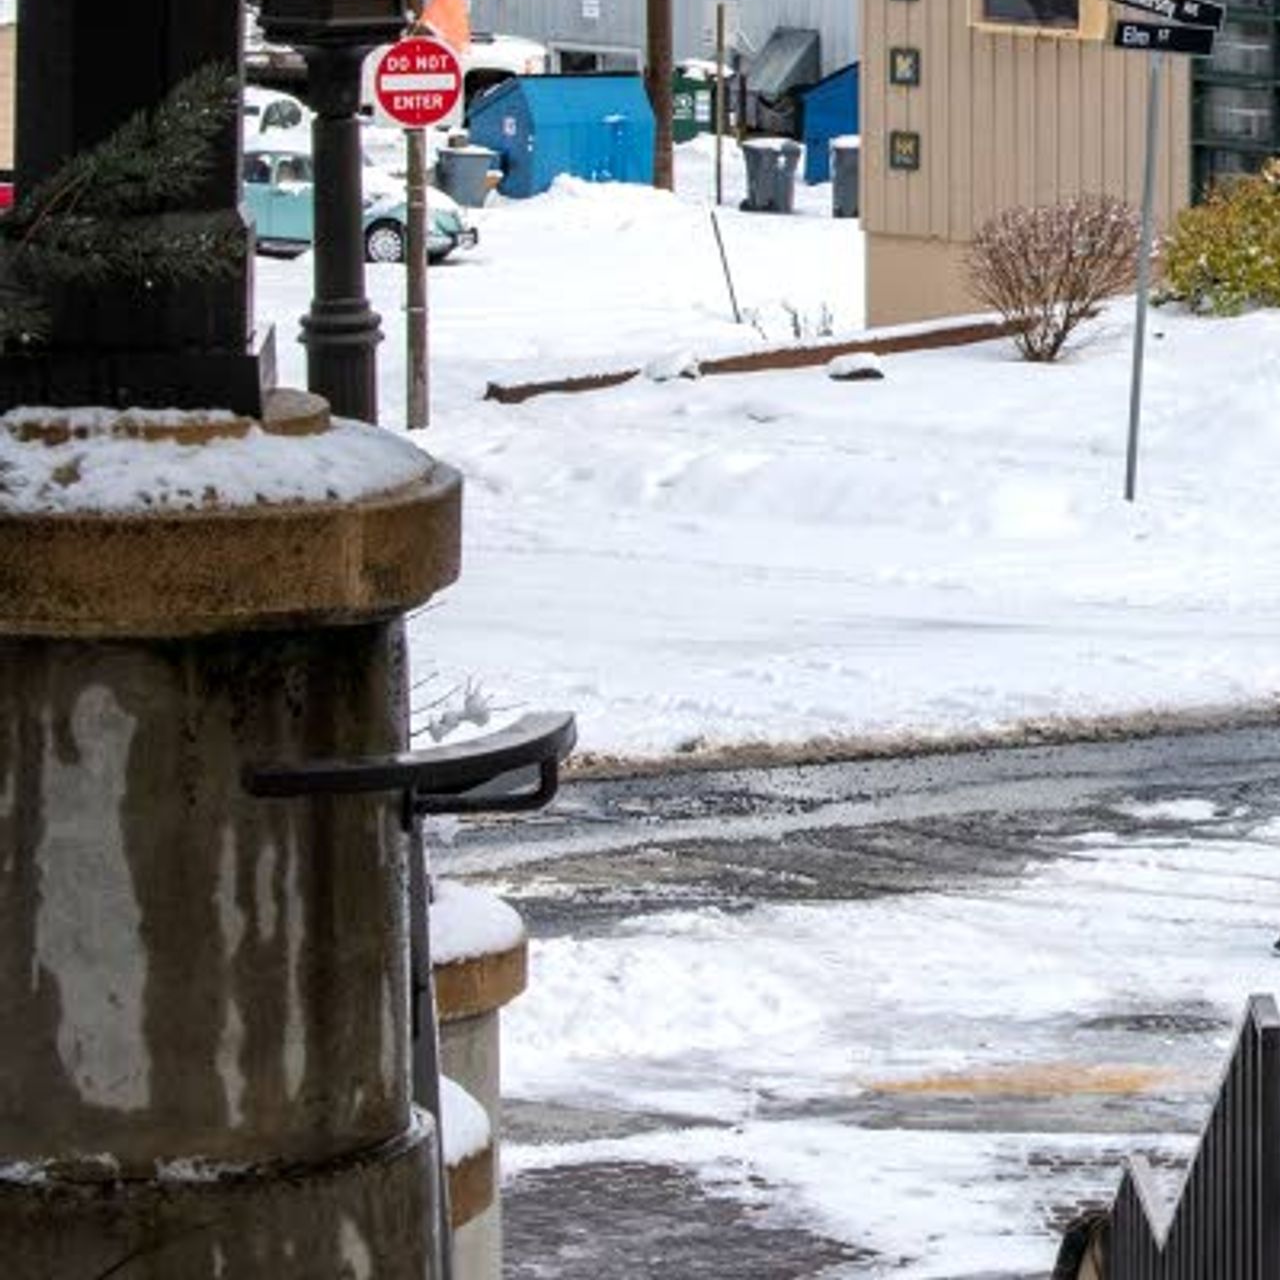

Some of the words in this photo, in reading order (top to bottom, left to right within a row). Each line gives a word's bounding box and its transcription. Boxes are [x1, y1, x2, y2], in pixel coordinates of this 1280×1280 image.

[1123, 25, 1150, 45] Elm
[386, 55, 411, 72] DO
[415, 54, 449, 70] NOT
[393, 93, 443, 110] ENTER
